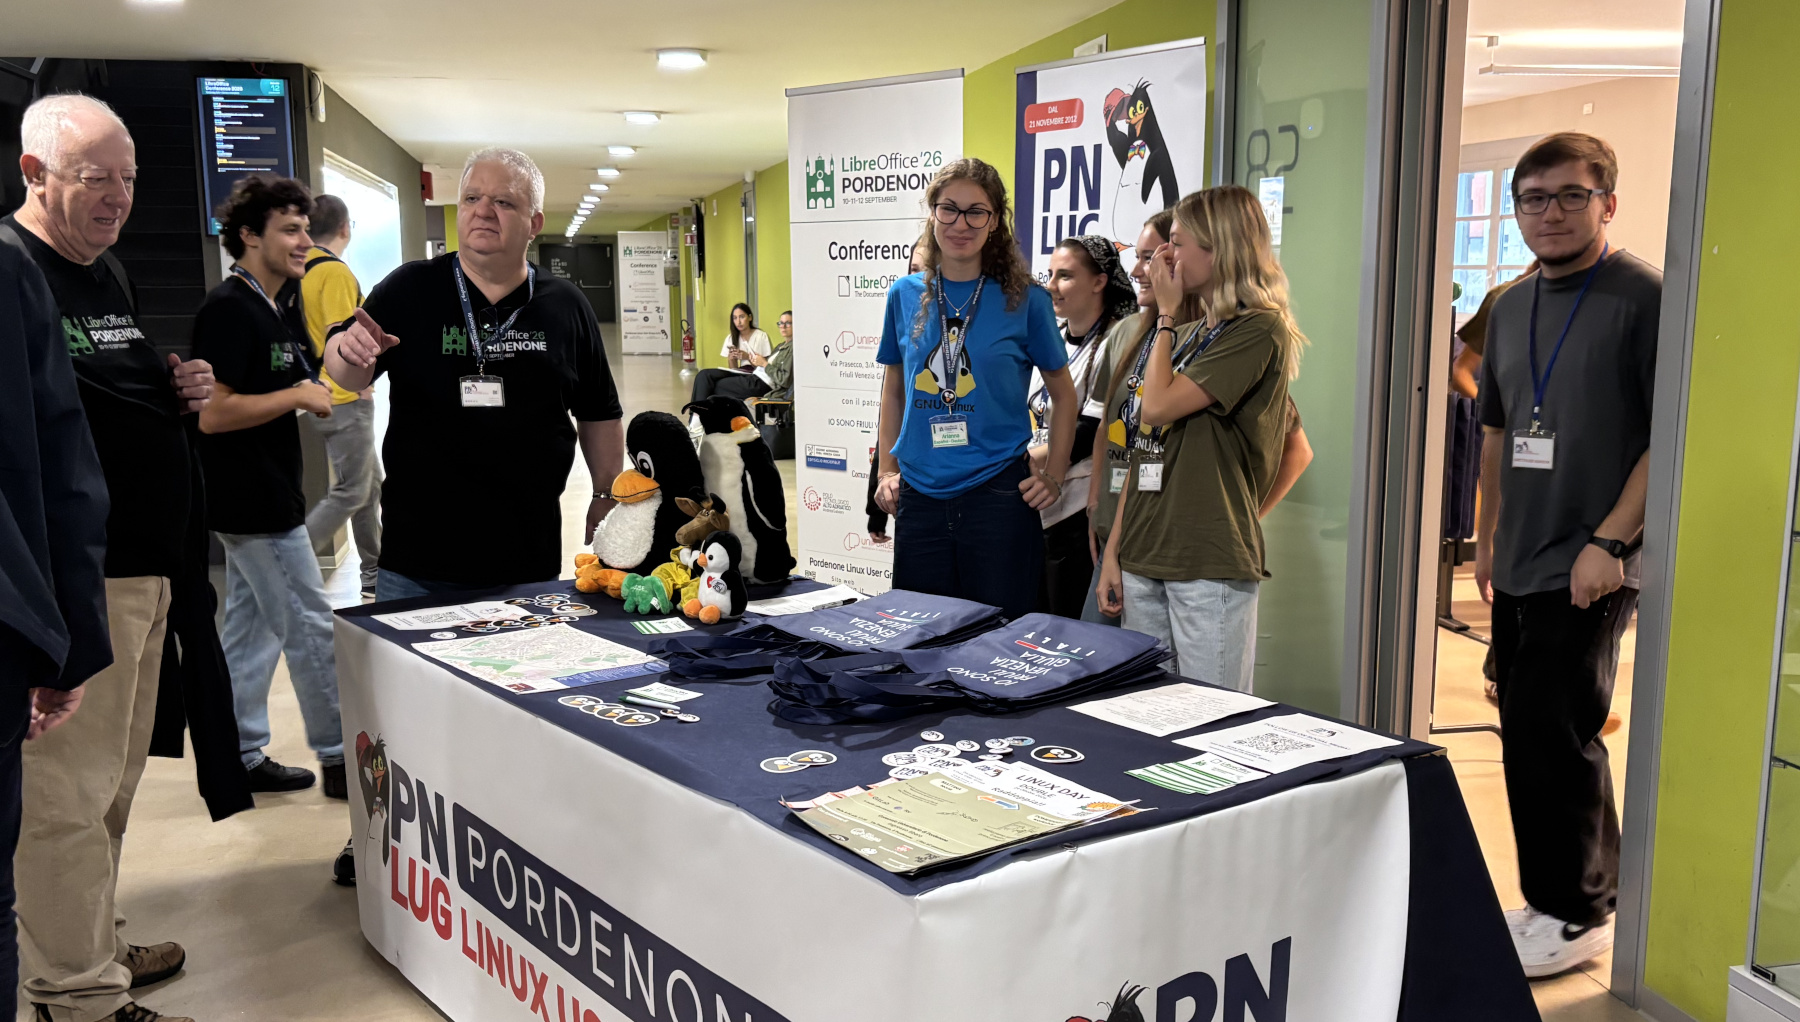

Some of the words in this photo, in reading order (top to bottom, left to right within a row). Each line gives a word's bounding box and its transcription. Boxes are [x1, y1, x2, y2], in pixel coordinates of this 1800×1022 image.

[1036, 117, 1064, 127] NOVEMBRE
[1064, 115, 1077, 124] 2012
[842, 172, 937, 193] PORDENON
[1043, 143, 1102, 212] PN
[828, 240, 910, 260] Conferenc
[854, 275, 898, 289] LibreOff
[486, 341, 547, 352] RDENONE
[914, 399, 975, 412] GNU/inux
[836, 419, 855, 427] SONO
[810, 557, 845, 571] Pordenone
[846, 564, 865, 574] Linux
[866, 567, 882, 577] User
[809, 626, 848, 642] SONO
[845, 629, 887, 645] FRIULI
[849, 617, 902, 638] VENEZIA
[1024, 631, 1096, 657] ITALY
[990, 656, 1052, 675] VENEZIA
[1020, 651, 1070, 668] GIULIA
[946, 667, 991, 682] SONO
[988, 669, 1038, 681] FRIULI
[1016, 774, 1061, 790] LINUX
[1058, 788, 1091, 800] DAY
[391, 760, 450, 880] PN
[391, 845, 453, 940] LUG
[467, 826, 752, 1022] PORDENO
[460, 906, 551, 1022] LINUX
[1156, 936, 1292, 1022] PN
